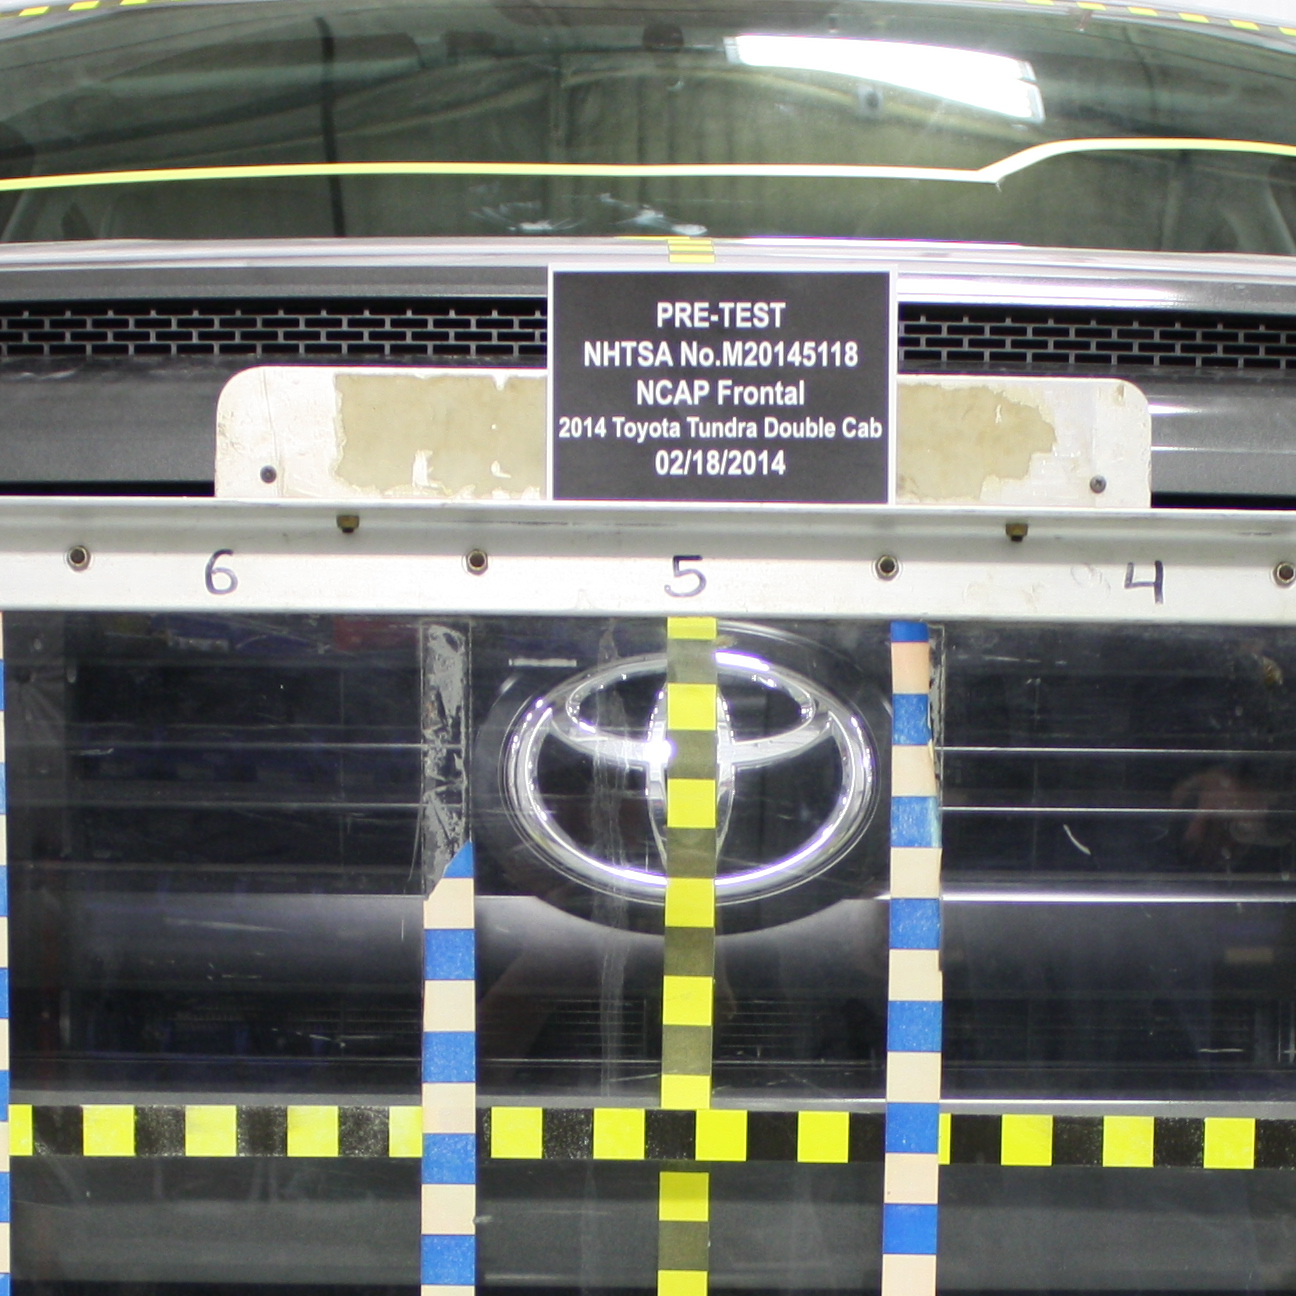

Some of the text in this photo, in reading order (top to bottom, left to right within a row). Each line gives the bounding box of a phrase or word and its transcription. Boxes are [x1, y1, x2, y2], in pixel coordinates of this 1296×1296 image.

[656, 301, 787, 329] PRE-TEST
[583, 340, 859, 368] NHTSA No.M20145118
[636, 378, 805, 406] NCAP Frontal
[558, 416, 883, 444] 2014 Toyota Tundra Double Cab
[654, 448, 787, 476] 02/18/2014
[204, 549, 239, 595] 6
[663, 554, 707, 599] 5
[1124, 559, 1166, 604] 4
